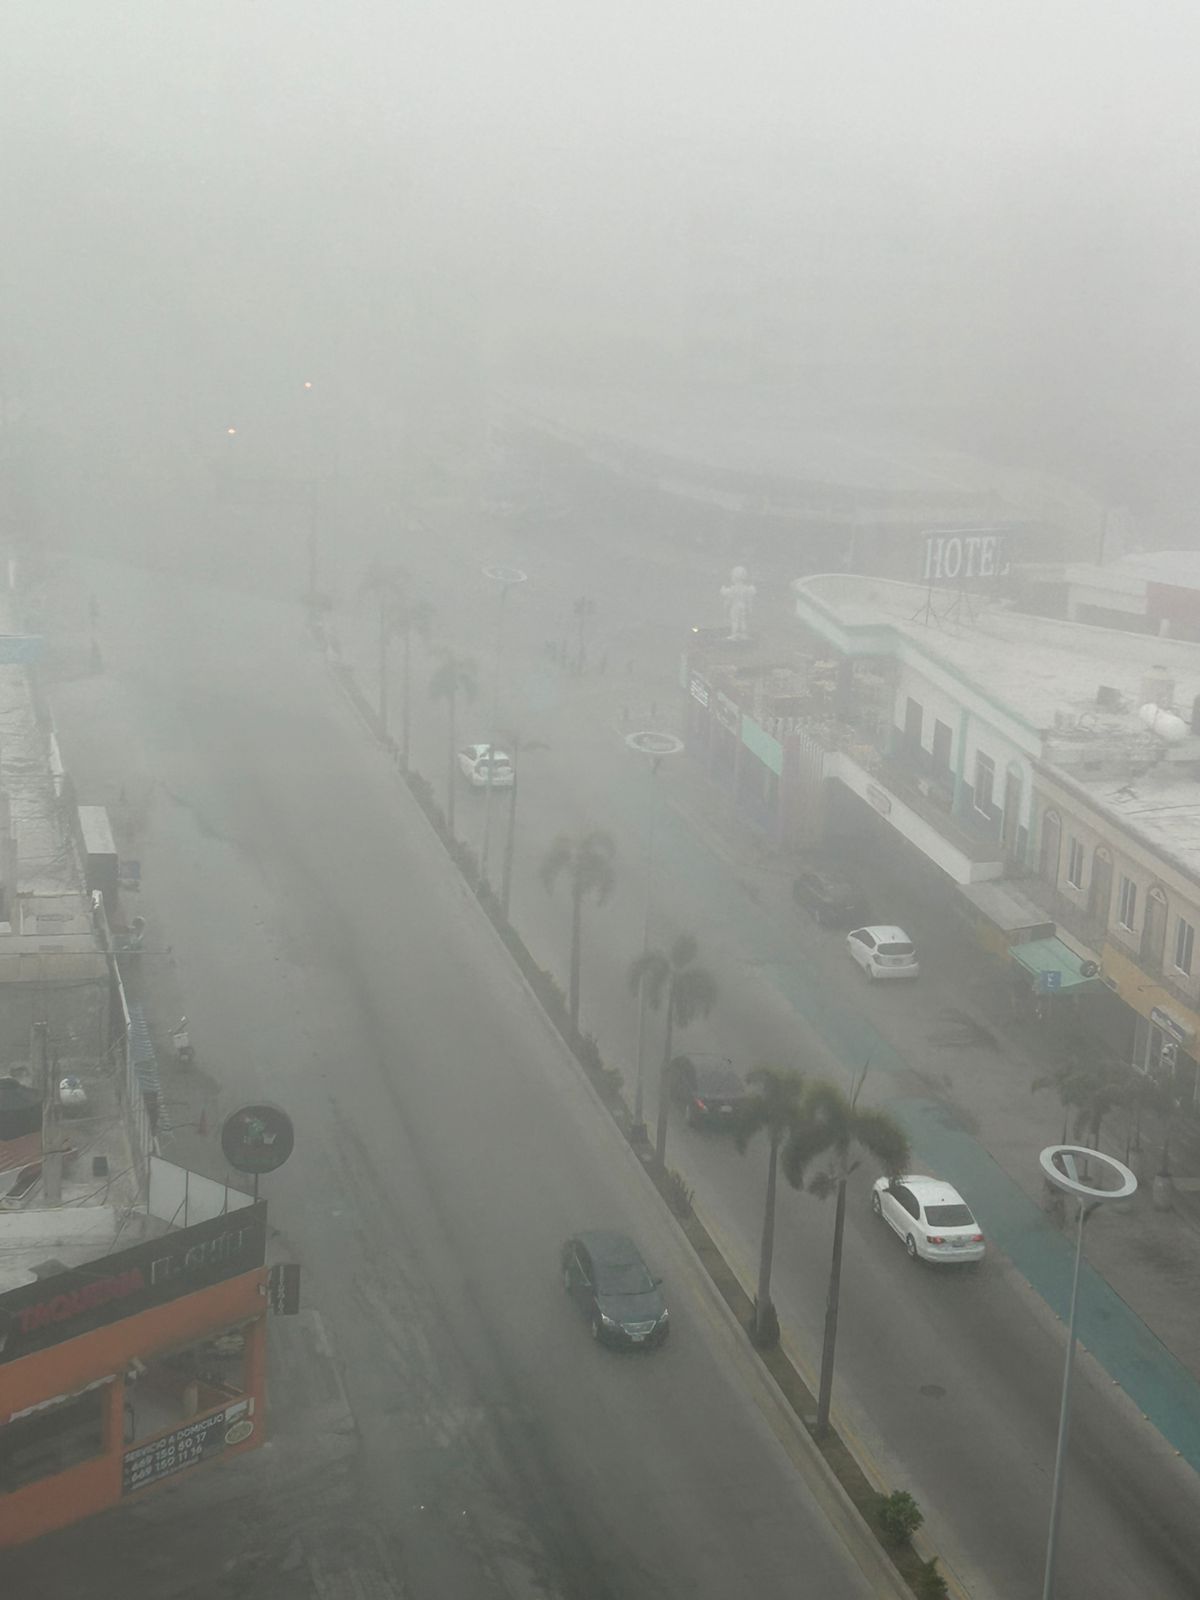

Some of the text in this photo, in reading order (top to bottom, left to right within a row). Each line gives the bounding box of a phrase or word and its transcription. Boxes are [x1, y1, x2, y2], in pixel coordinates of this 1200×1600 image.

[922, 536, 1010, 578] HOTEL
[124, 1439, 166, 1463] SERVICIO
[168, 1435, 176, 1446] A
[176, 1413, 224, 1440] DOMICILIO
